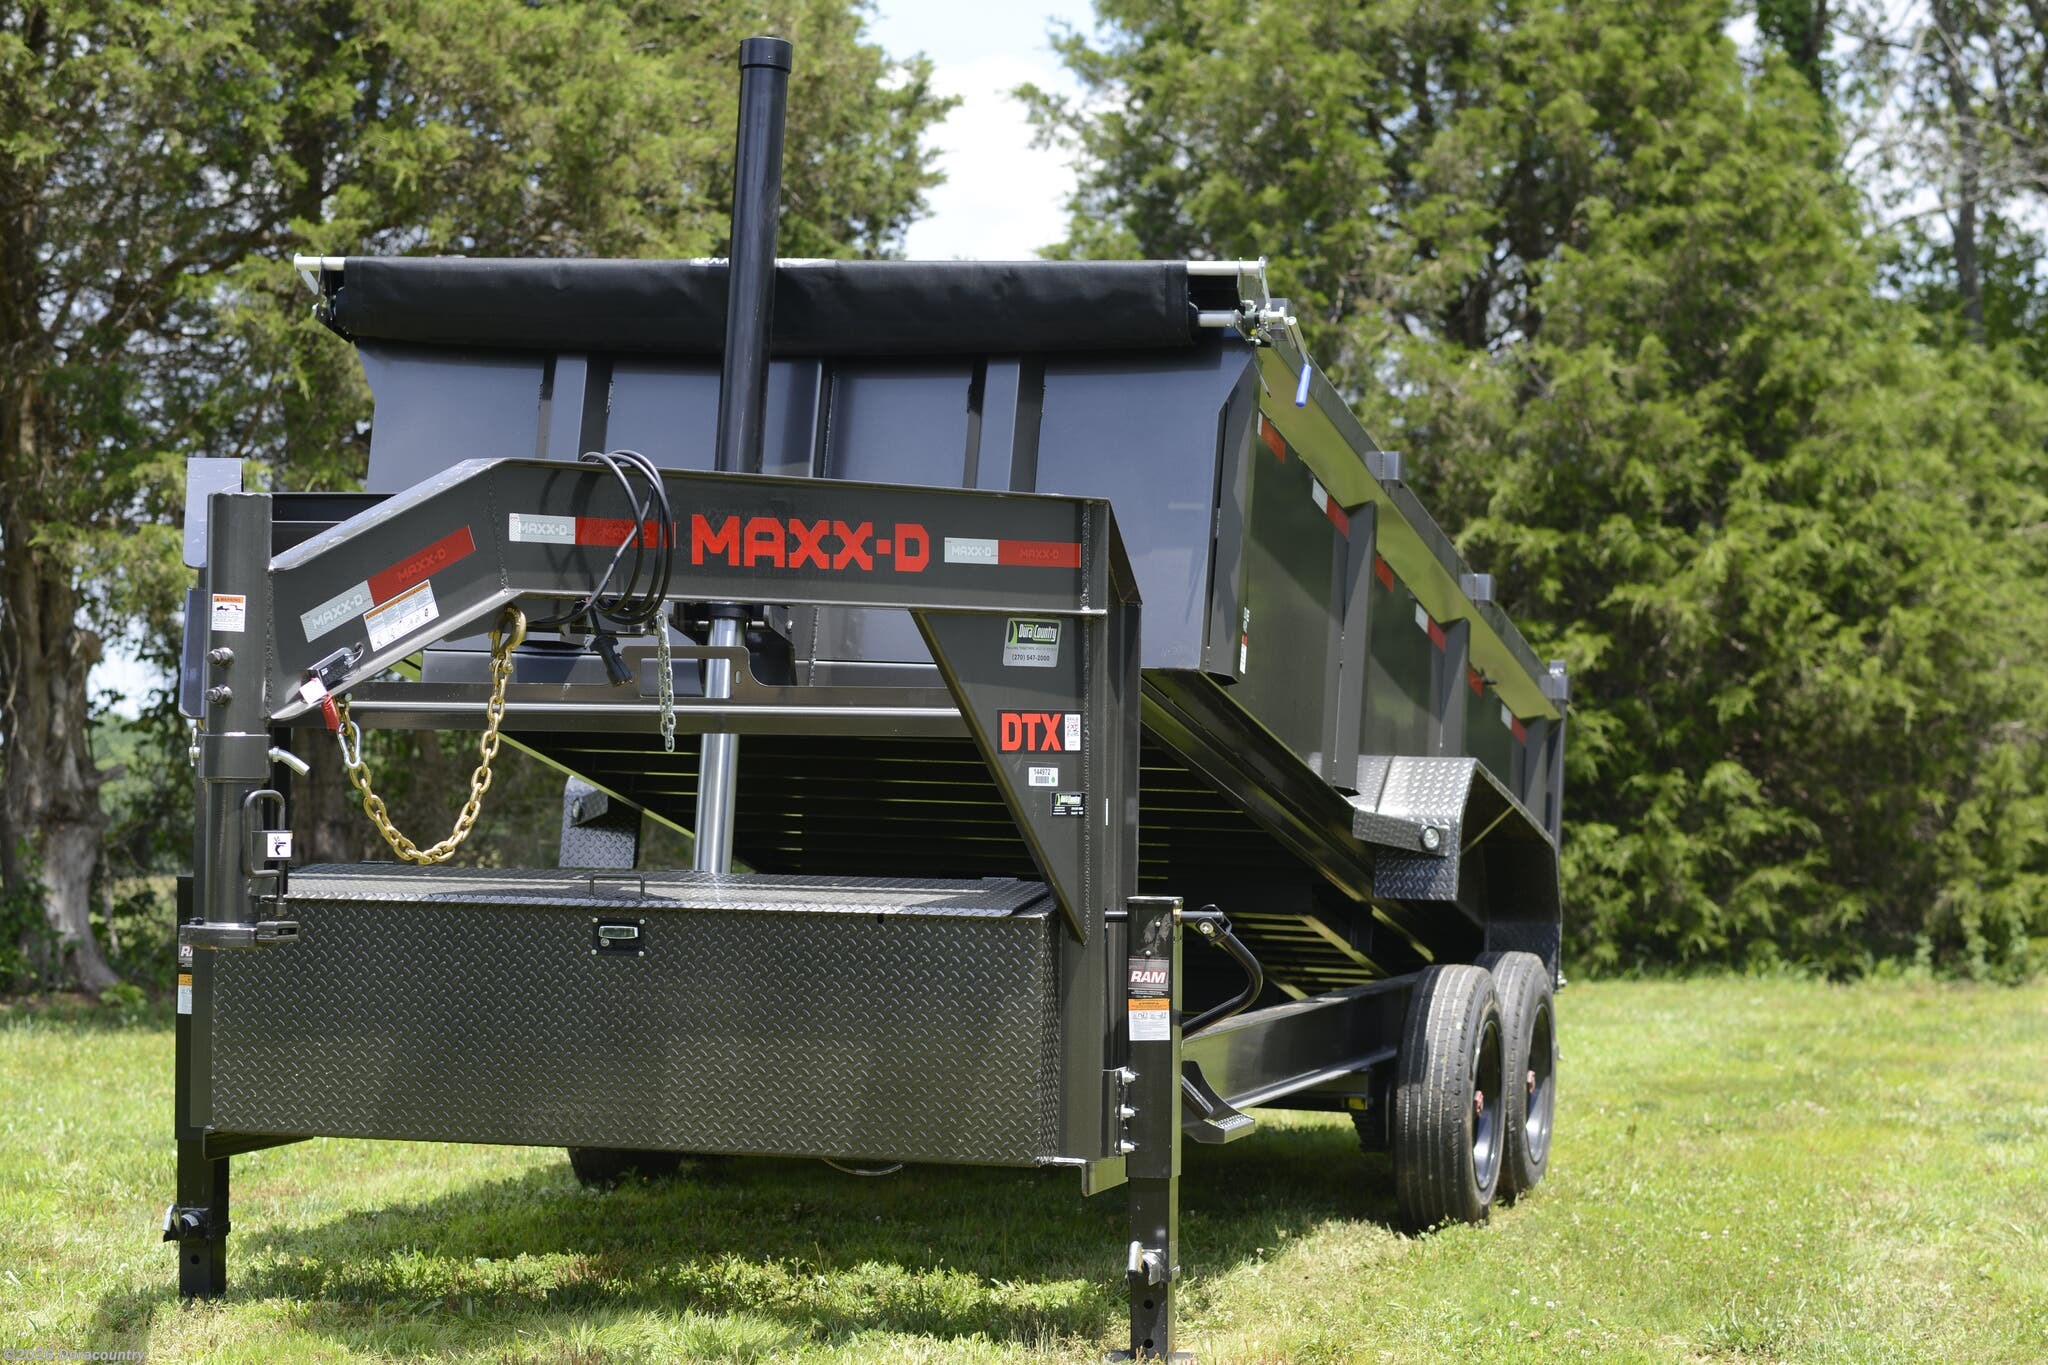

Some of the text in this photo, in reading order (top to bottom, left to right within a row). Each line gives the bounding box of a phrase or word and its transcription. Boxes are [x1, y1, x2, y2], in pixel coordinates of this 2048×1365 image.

[519, 521, 568, 536] MAXX-D
[691, 513, 930, 573] MAXX-D
[395, 549, 446, 581] MAXX-D
[951, 545, 992, 558] MAXX-D
[311, 593, 364, 630] MAXX-D
[1001, 712, 1062, 751] DTX
[1130, 970, 1167, 984] RAM
